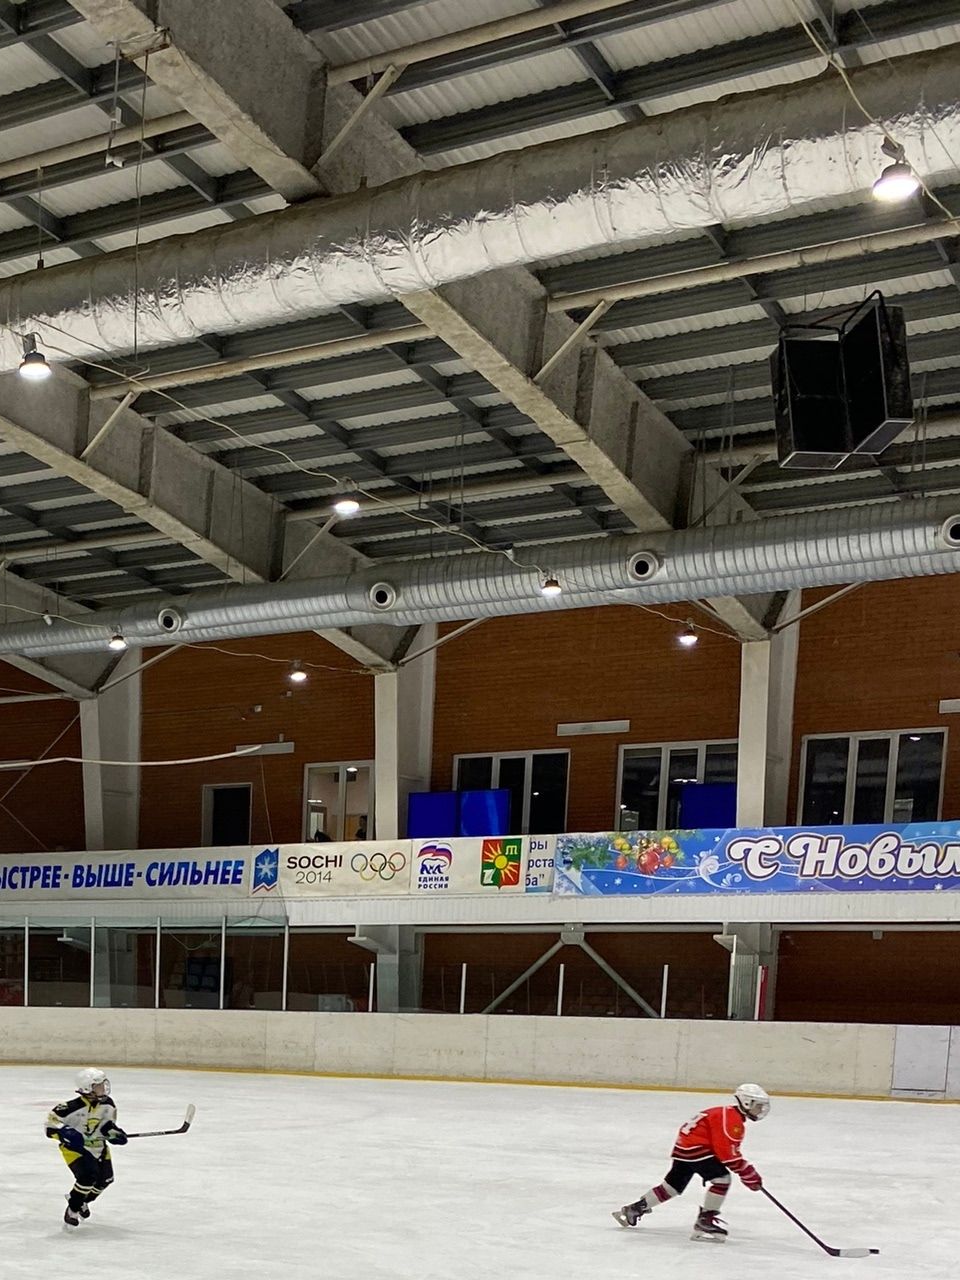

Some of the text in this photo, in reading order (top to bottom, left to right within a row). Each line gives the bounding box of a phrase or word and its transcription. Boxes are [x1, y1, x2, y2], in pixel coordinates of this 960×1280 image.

[286, 855, 343, 870] SOCHI
[729, 838, 783, 880] С
[295, 870, 333, 884] 2014
